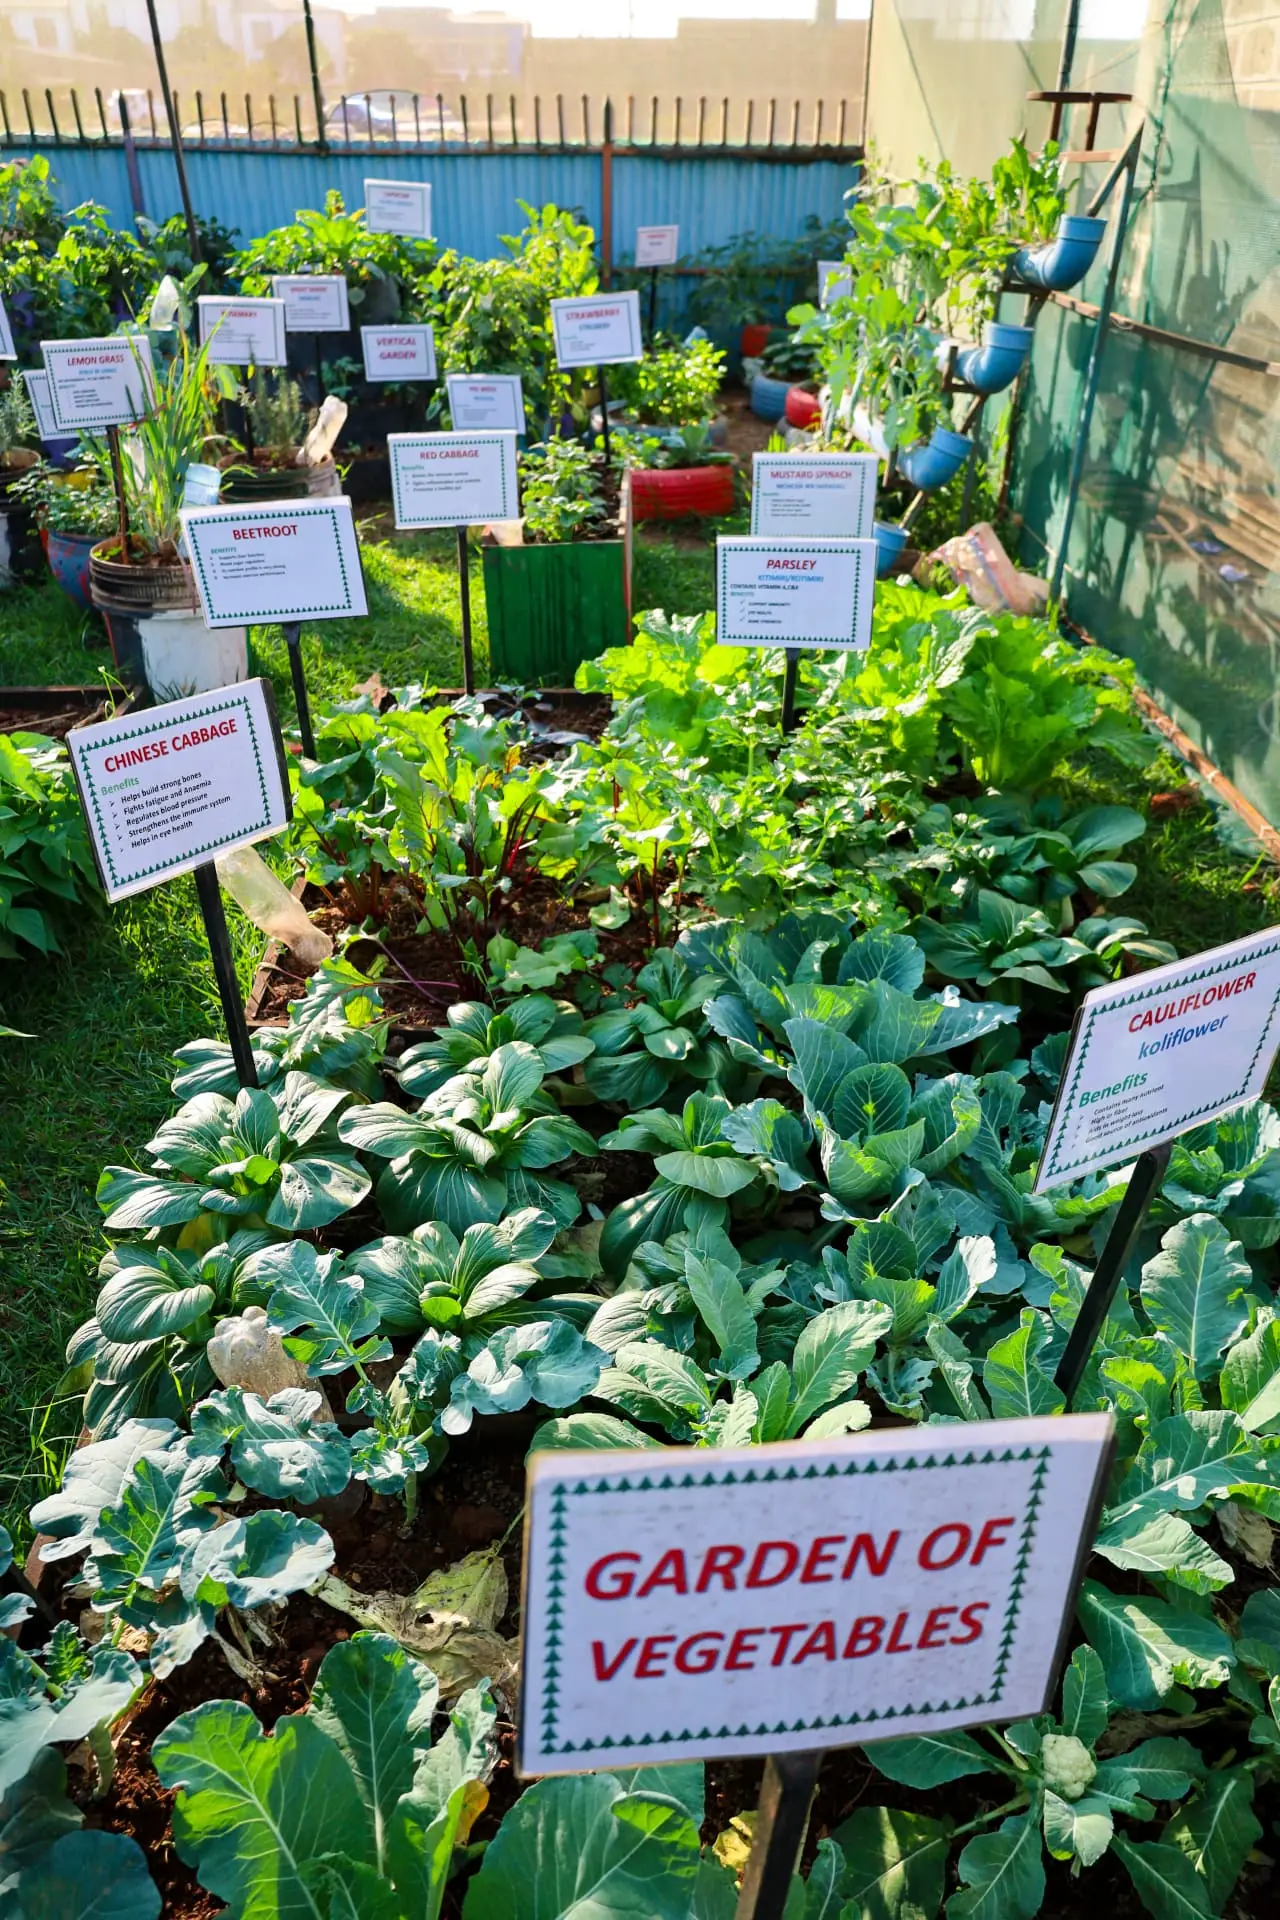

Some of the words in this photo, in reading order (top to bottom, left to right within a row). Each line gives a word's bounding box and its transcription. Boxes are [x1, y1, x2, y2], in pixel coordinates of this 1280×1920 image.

[565, 308, 620, 321] STRAWBERRY
[376, 337, 416, 346] VERTICAL
[67, 356, 97, 366] LEMON
[99, 354, 124, 364] GRASS
[379, 351, 416, 360] GARDEN
[420, 451, 437, 460] RED
[439, 449, 479, 459] CABBAGE
[770, 470, 814, 479] MUSTARD
[815, 470, 852, 479] SPINACH
[232, 524, 299, 541] BEETROOT
[766, 559, 817, 570] PARSLEY
[104, 740, 169, 772] CHINESE
[171, 718, 237, 752] CABBAGE
[100, 776, 140, 796] Benefits
[121, 793, 141, 804] Helps
[141, 784, 159, 796] build
[160, 778, 181, 791] strong
[182, 771, 202, 783] bones
[123, 803, 145, 816] Fights
[145, 794, 169, 808] fatigue
[170, 788, 183, 799] and
[183, 779, 212, 793] Anaemia
[126, 810, 160, 827] Regulates
[160, 803, 180, 814] blood
[181, 793, 208, 807] pressure
[128, 818, 172, 838] Strengthens
[170, 814, 181, 825] the
[182, 804, 208, 818] immune
[209, 796, 231, 811] system
[131, 836, 151, 848] Helps
[151, 832, 159, 840] in
[160, 829, 171, 839] eye
[172, 820, 193, 833] health
[1128, 972, 1257, 1033] CAULIFLOWER
[1137, 1014, 1229, 1060] koliflower
[1079, 1072, 1148, 1108] Benefits
[1094, 1101, 1121, 1116] Contains
[1121, 1095, 1139, 1105] many
[1091, 1115, 1106, 1125] High
[584, 1529, 901, 1601] GARDEN
[916, 1516, 1016, 1571] OF
[590, 1602, 990, 1681] VEGETABLES
